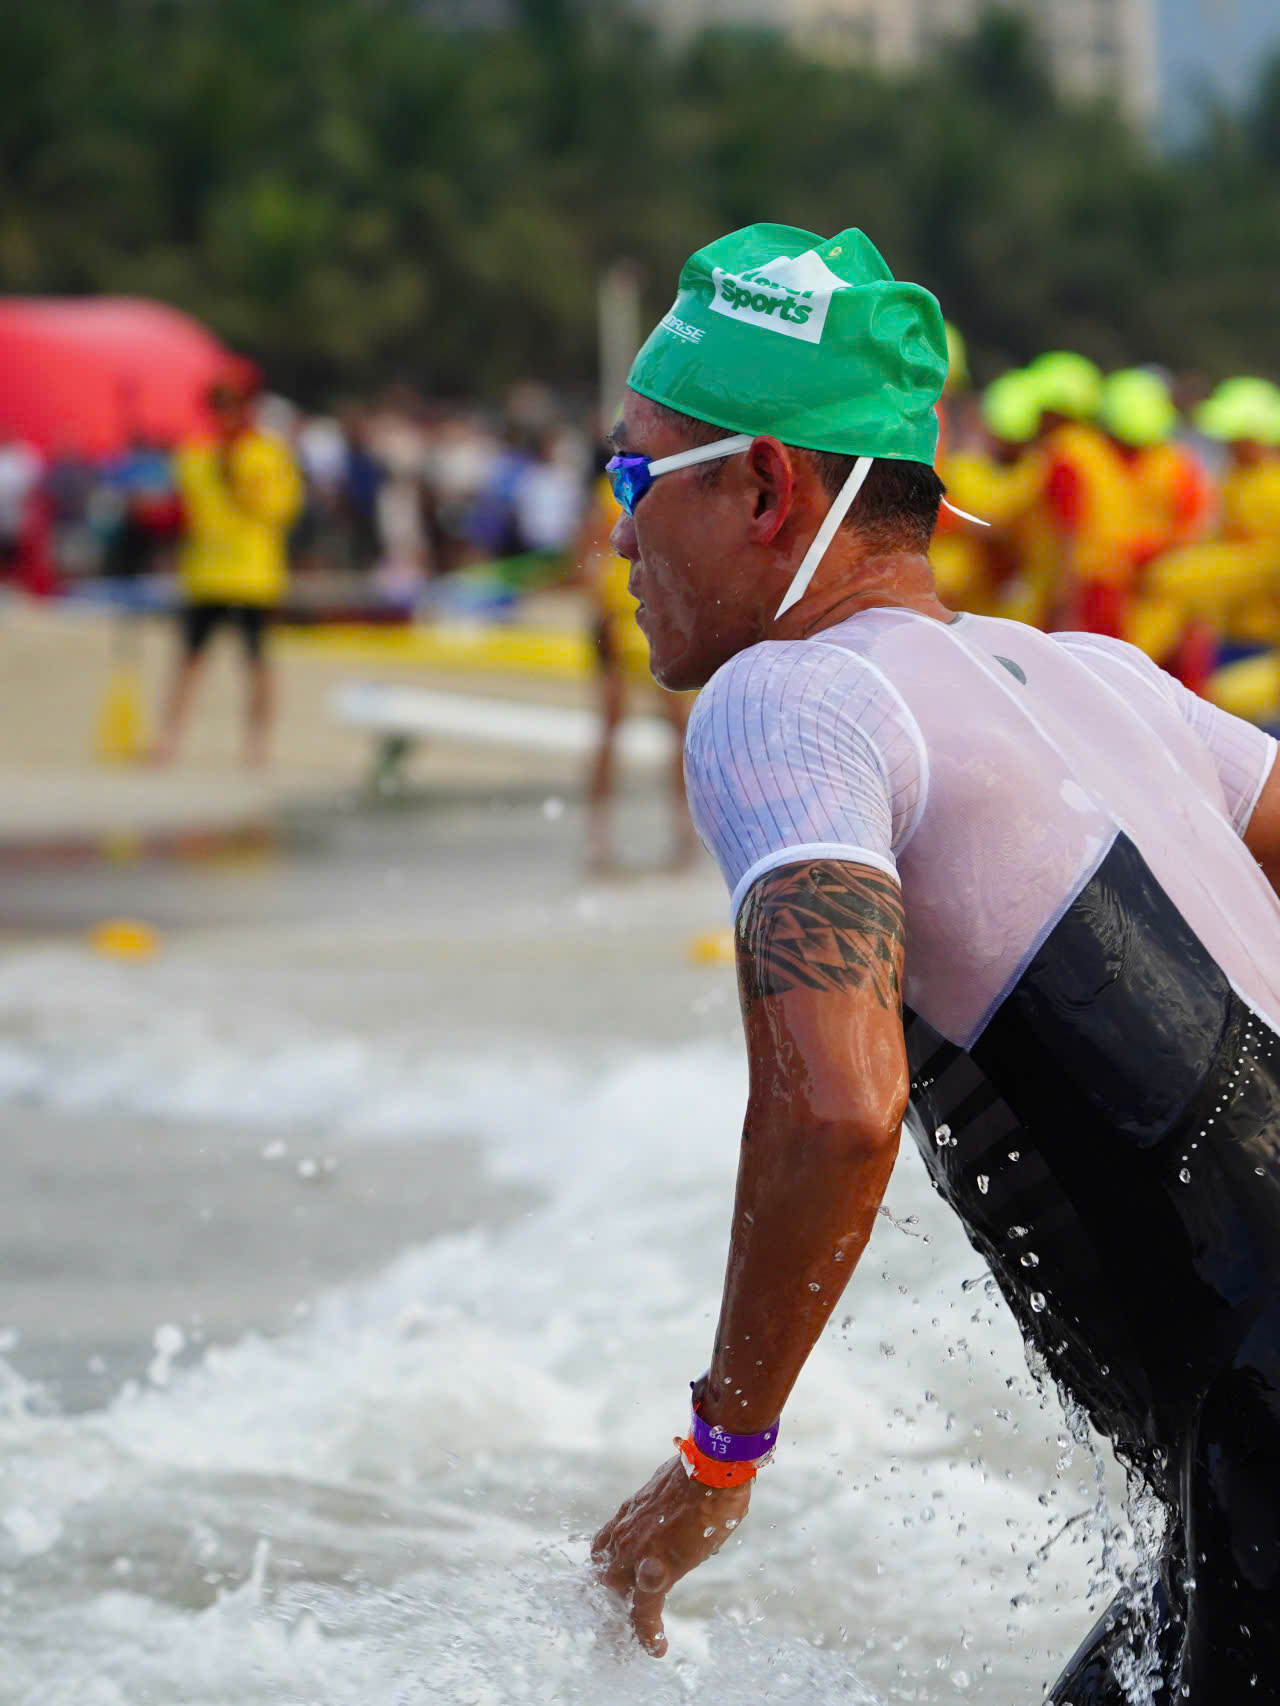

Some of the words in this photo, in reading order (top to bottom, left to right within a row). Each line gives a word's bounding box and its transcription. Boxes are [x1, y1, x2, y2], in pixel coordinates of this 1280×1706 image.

[721, 278, 813, 325] sports
[709, 1430, 732, 1444] BAG
[711, 1441, 727, 1454] 13
